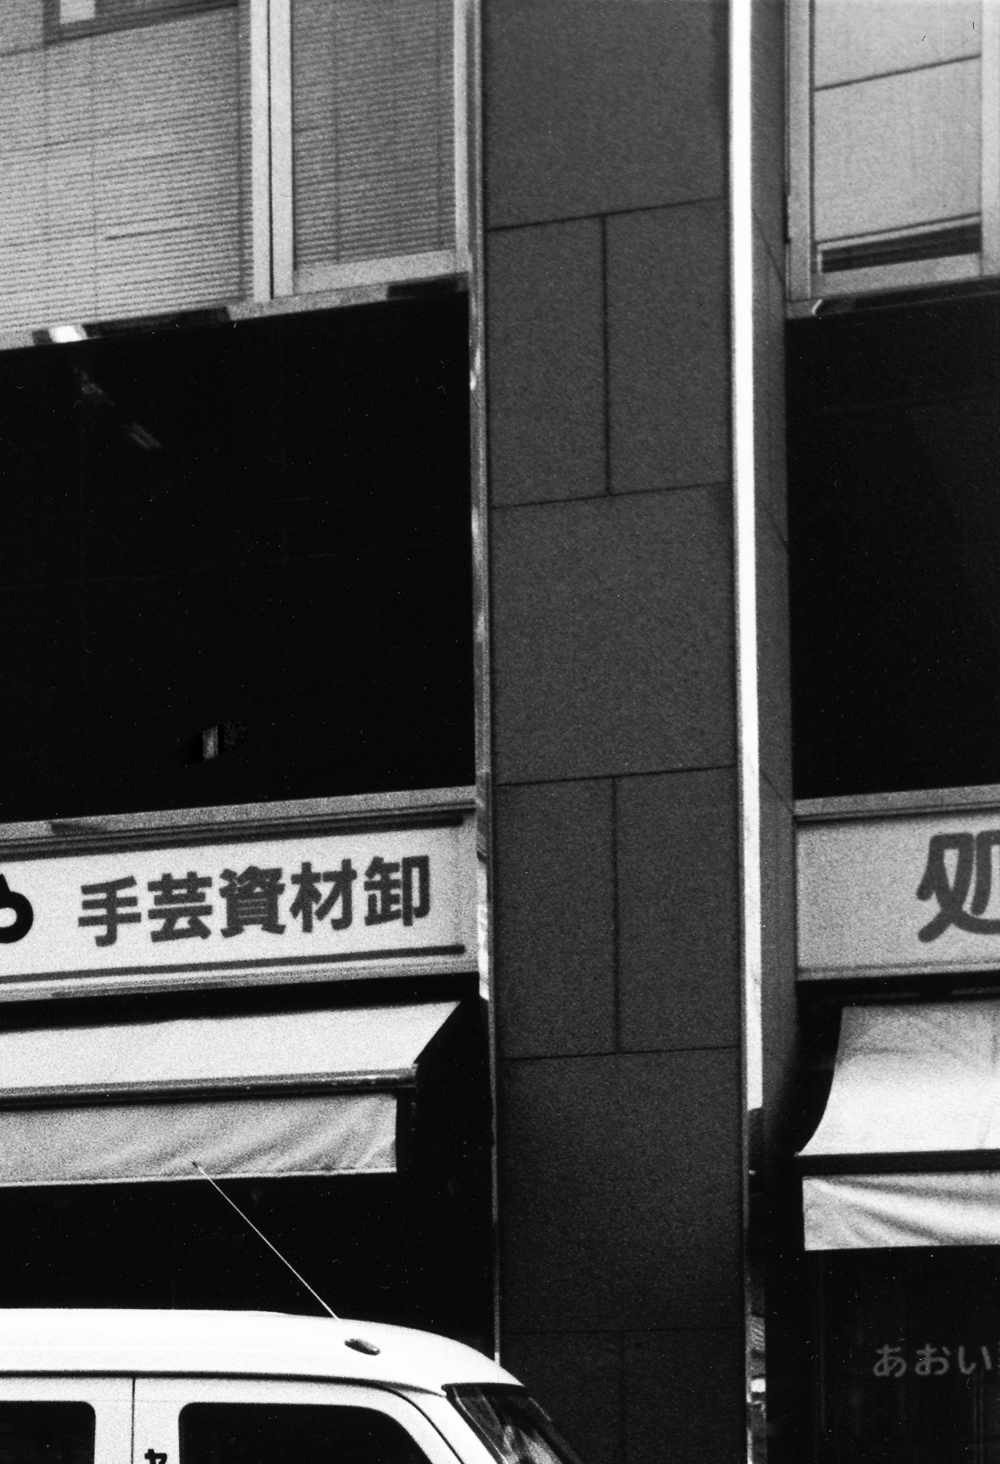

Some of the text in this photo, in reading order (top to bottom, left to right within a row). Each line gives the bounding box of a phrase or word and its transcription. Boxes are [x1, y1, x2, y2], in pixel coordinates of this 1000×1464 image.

[78, 855, 430, 947] 手芸資材卸
[873, 1343, 1000, 1377] あおい
